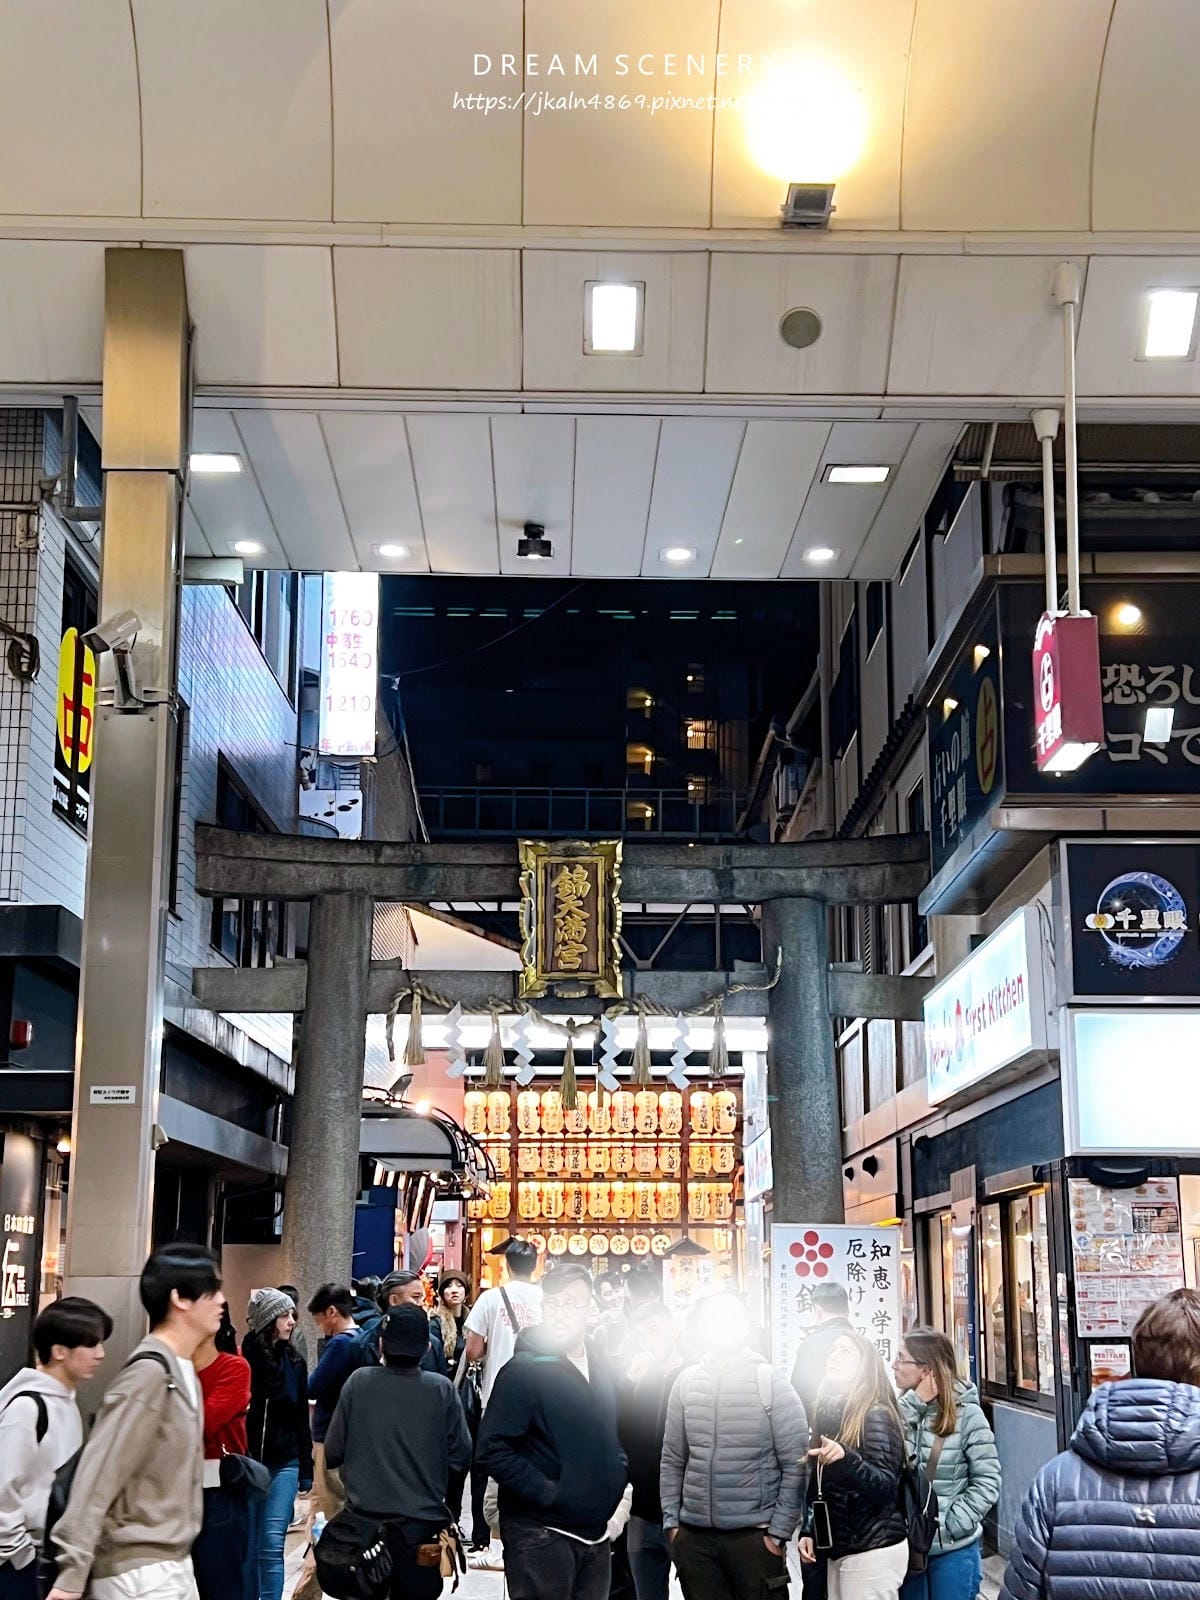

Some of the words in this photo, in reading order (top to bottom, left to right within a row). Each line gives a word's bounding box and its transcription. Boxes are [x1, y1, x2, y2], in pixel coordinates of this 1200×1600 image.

[329, 609, 374, 626] 1760
[328, 652, 373, 669] 1540
[1102, 663, 1200, 705] 恐ろし
[326, 695, 371, 712] 1210
[551, 864, 592, 970] 錦天満宮
[1115, 908, 1188, 930] 千里眼
[987, 973, 1024, 1026] Kitchen
[870, 1239, 891, 1362] 知恵・学問
